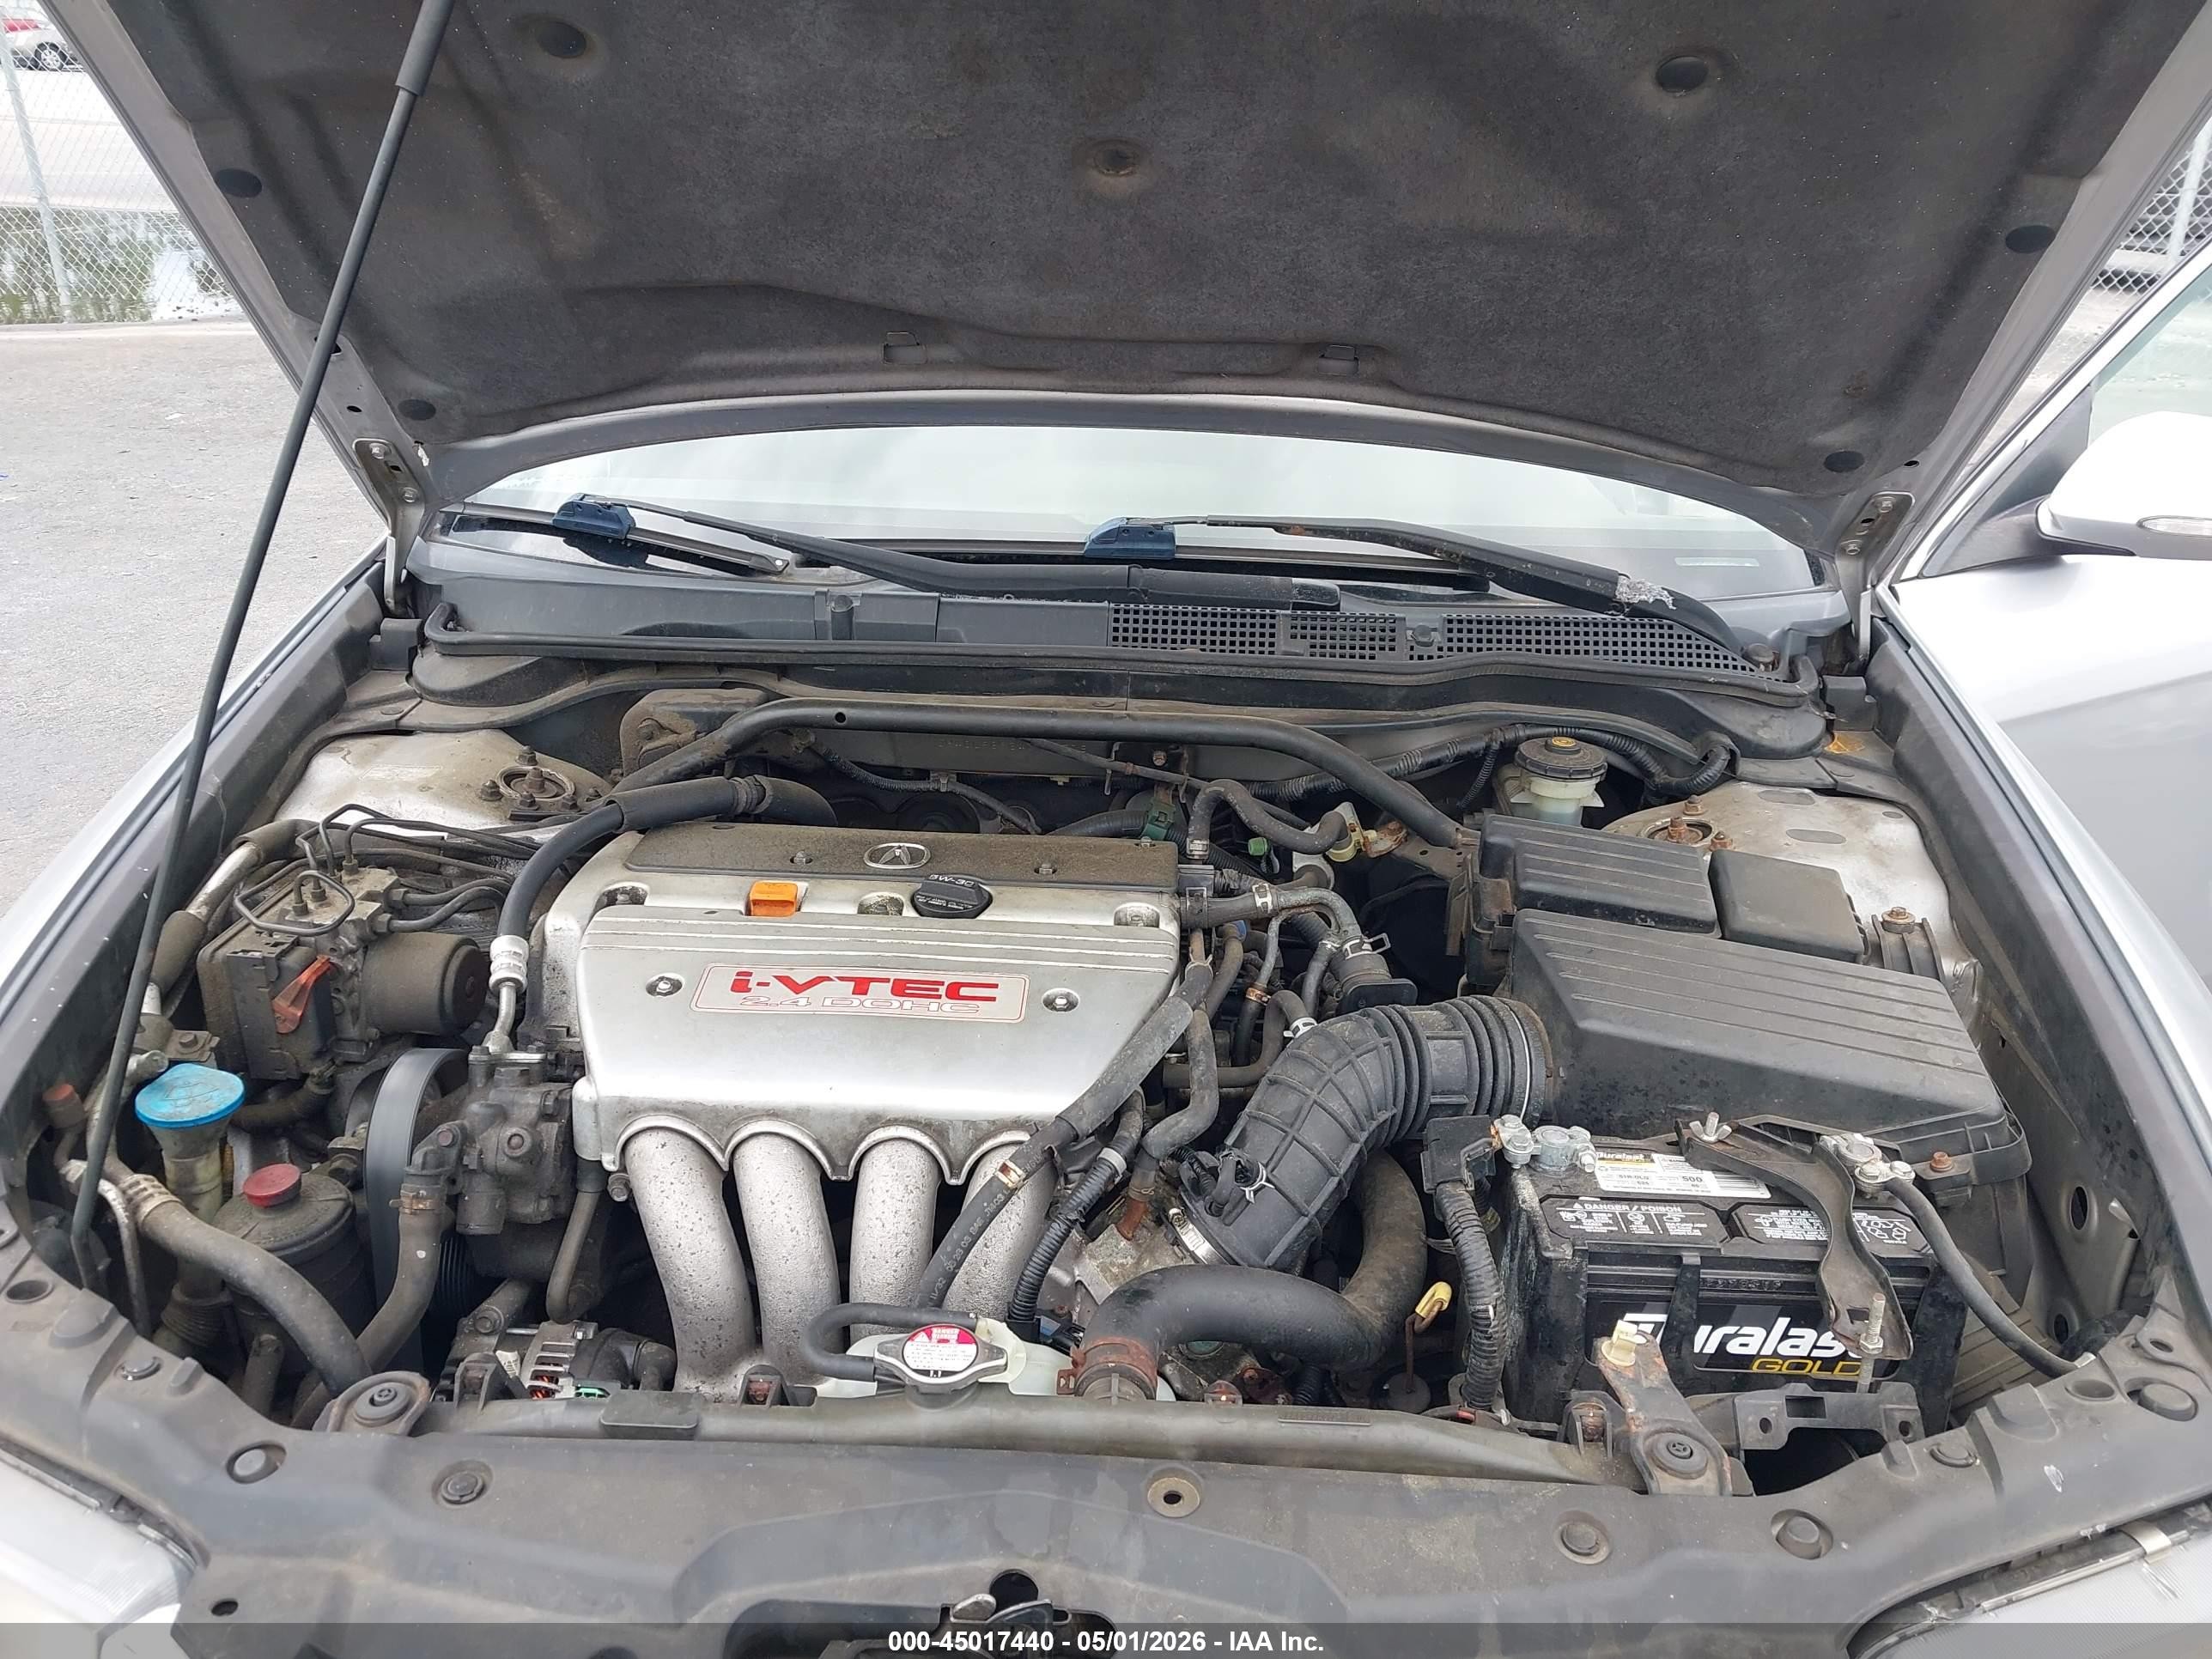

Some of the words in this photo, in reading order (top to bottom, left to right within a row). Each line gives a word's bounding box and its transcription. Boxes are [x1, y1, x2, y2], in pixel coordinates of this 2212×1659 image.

[928, 874, 975, 888] 5W-30
[730, 970, 1000, 1002] i-VTEC
[740, 994, 811, 1008] 2.4
[822, 997, 980, 1014] DOHC
[1682, 1175, 1703, 1183] 500
[1583, 1203, 1630, 1212] DANGER
[1752, 1358, 1862, 1376] GOLD
